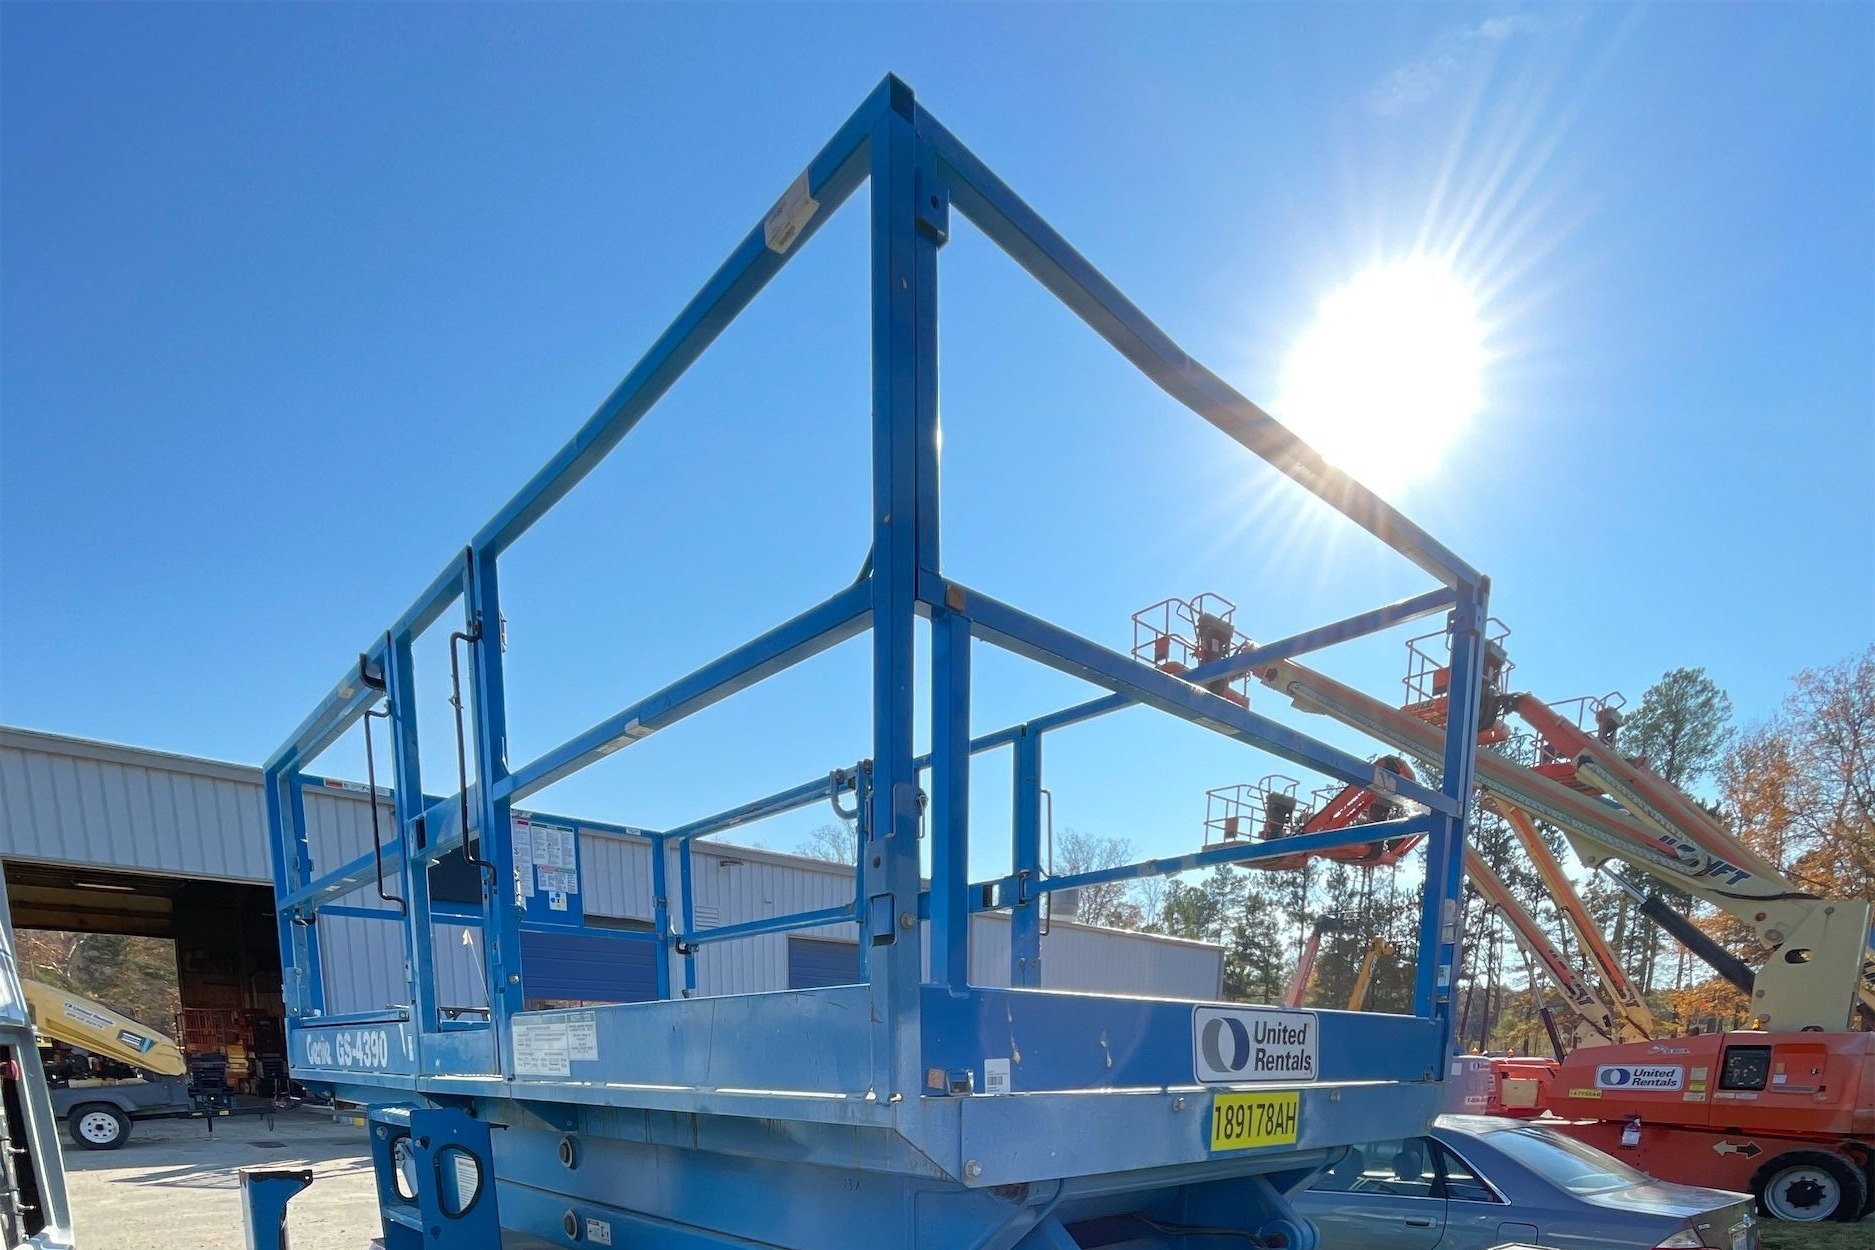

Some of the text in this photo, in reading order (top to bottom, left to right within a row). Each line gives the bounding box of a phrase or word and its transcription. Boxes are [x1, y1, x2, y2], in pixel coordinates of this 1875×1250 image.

[1254, 1020, 1307, 1045] United
[306, 1030, 388, 1068] Genie GS-4390
[1254, 1048, 1311, 1072] Rentals
[1631, 1077, 1678, 1087] Rentals
[1633, 1068, 1676, 1078] United
[1214, 1102, 1297, 1141] 189178AH
